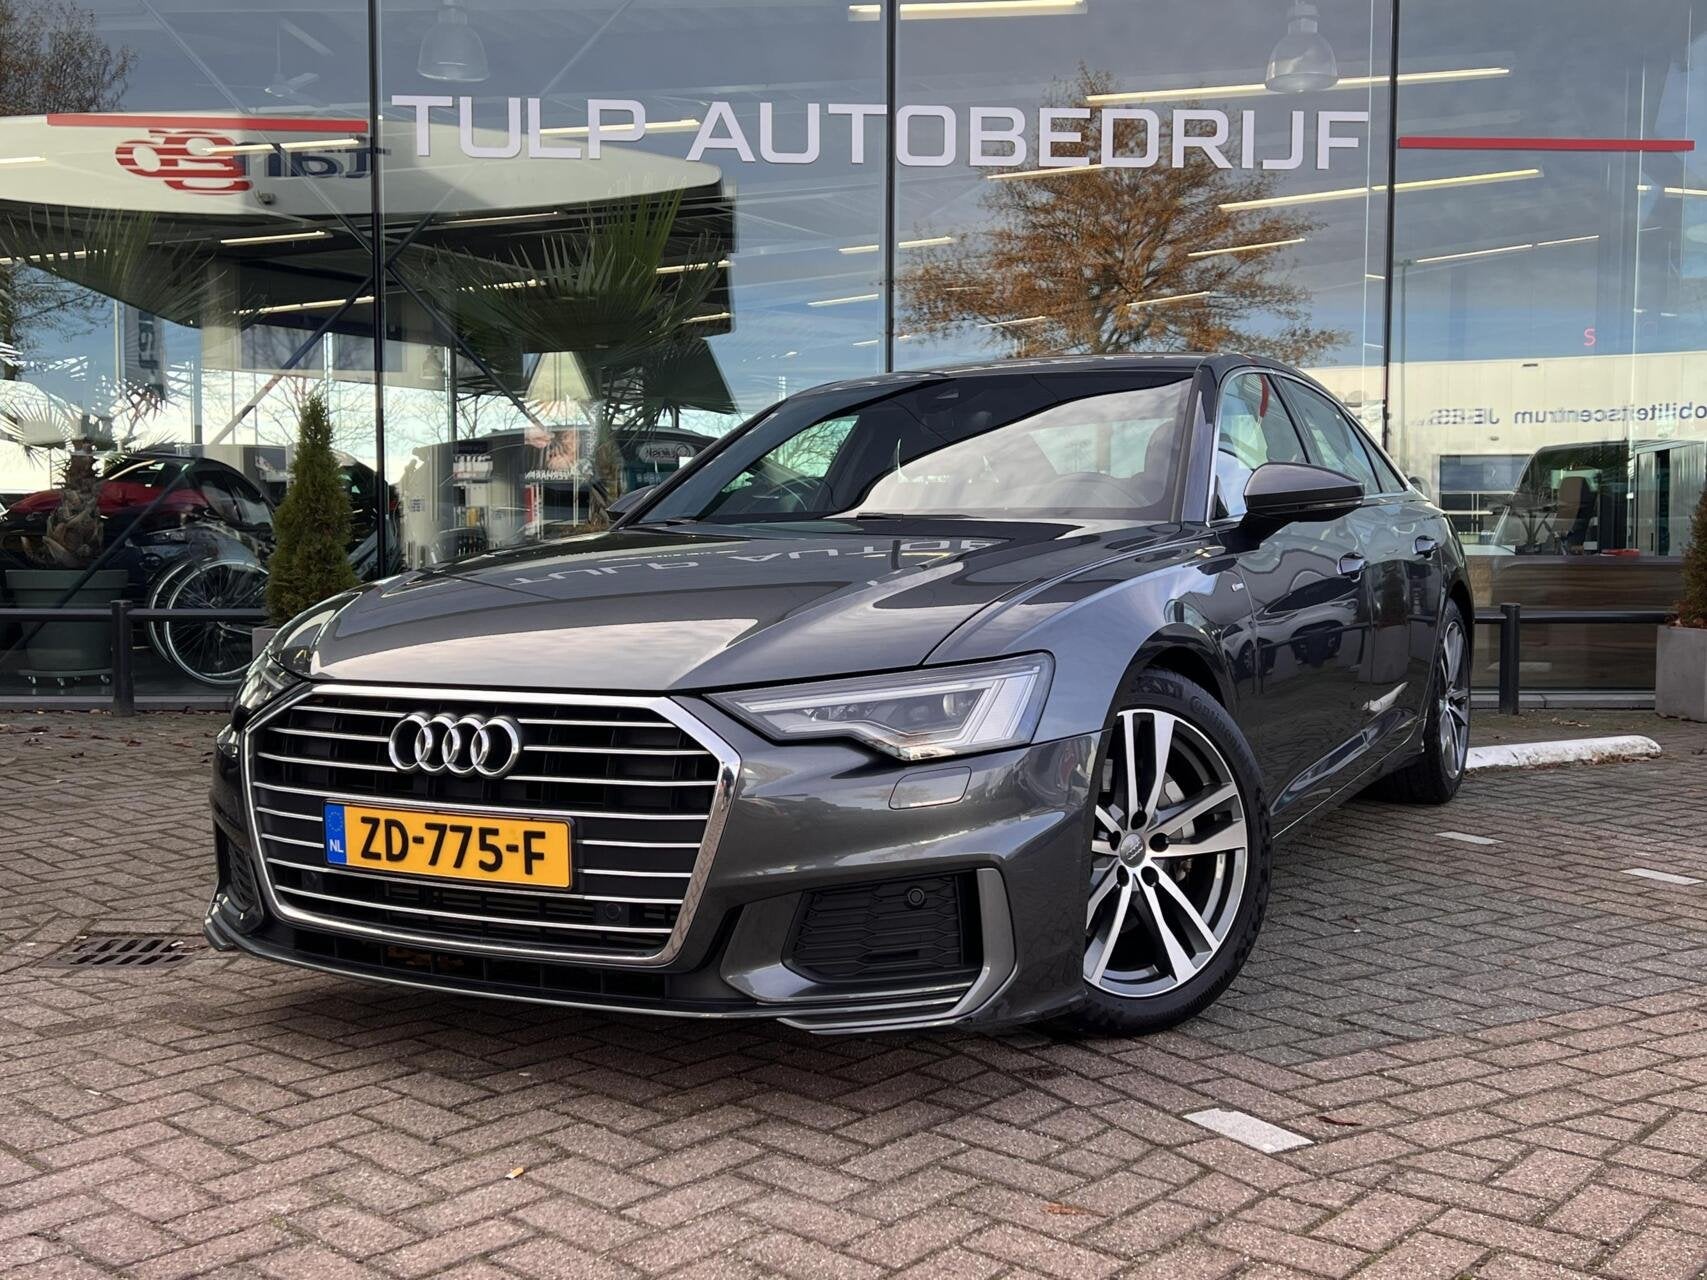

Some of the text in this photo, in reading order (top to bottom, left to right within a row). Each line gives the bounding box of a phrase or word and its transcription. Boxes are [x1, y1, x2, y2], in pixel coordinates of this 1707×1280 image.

[391, 95, 1369, 170] TULP AUTOBEDRIJF
[329, 816, 546, 876] NL ZD-775-F
